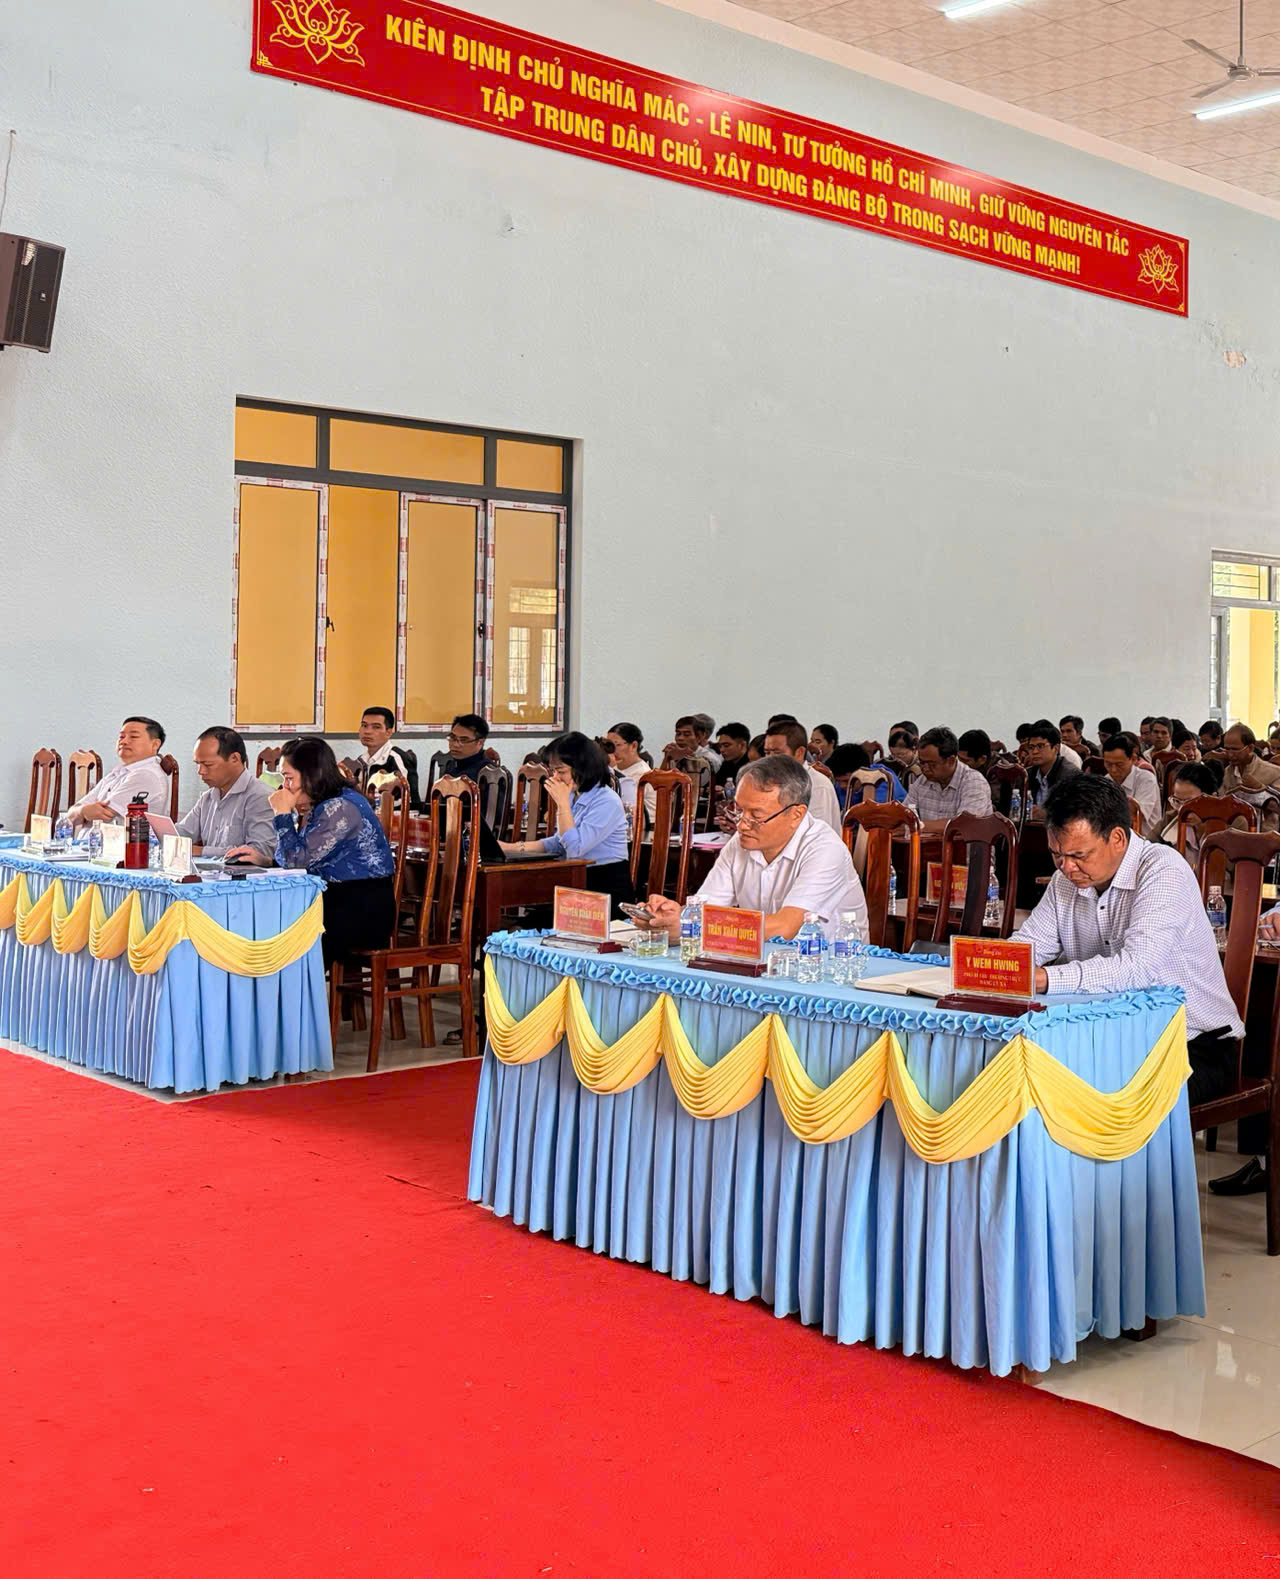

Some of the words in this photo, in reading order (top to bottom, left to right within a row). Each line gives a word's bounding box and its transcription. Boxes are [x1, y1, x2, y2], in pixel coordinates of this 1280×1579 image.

[385, 15, 445, 56] KIÊN
[453, 36, 511, 75] ĐỊNH
[518, 55, 564, 89] CHỦ
[571, 72, 637, 111] NGHĨA
[644, 91, 690, 126] MÁC
[709, 110, 732, 140] LÊ
[738, 123, 776, 154] NIN,
[782, 133, 806, 159] TƯ
[810, 141, 866, 178] TƯỞNG
[872, 157, 894, 185] HỒ
[899, 166, 925, 192] CHÍ
[930, 178, 976, 213] MINH,
[979, 192, 1005, 218] GIỮ
[1008, 201, 1046, 233] VỮNG
[1049, 211, 1102, 250] NGUYÊN
[1106, 227, 1129, 257] TẮC
[480, 86, 524, 122] TẬP
[532, 100, 605, 144] TRUNG
[612, 121, 655, 158] DÂN
[661, 138, 708, 175] CHỦ,
[714, 151, 750, 183] XÂY
[757, 163, 808, 198] DỰNG
[812, 175, 861, 212] ĐẢNG
[865, 191, 888, 224] BỘ
[893, 200, 945, 236] TRONG
[949, 217, 989, 250] SẠCH
[993, 229, 1032, 260] VỮNG
[1035, 243, 1081, 275] MẠNH!
[966, 956, 971, 967] Y
[972, 957, 991, 969] WEM
[993, 959, 1020, 972] HWING
